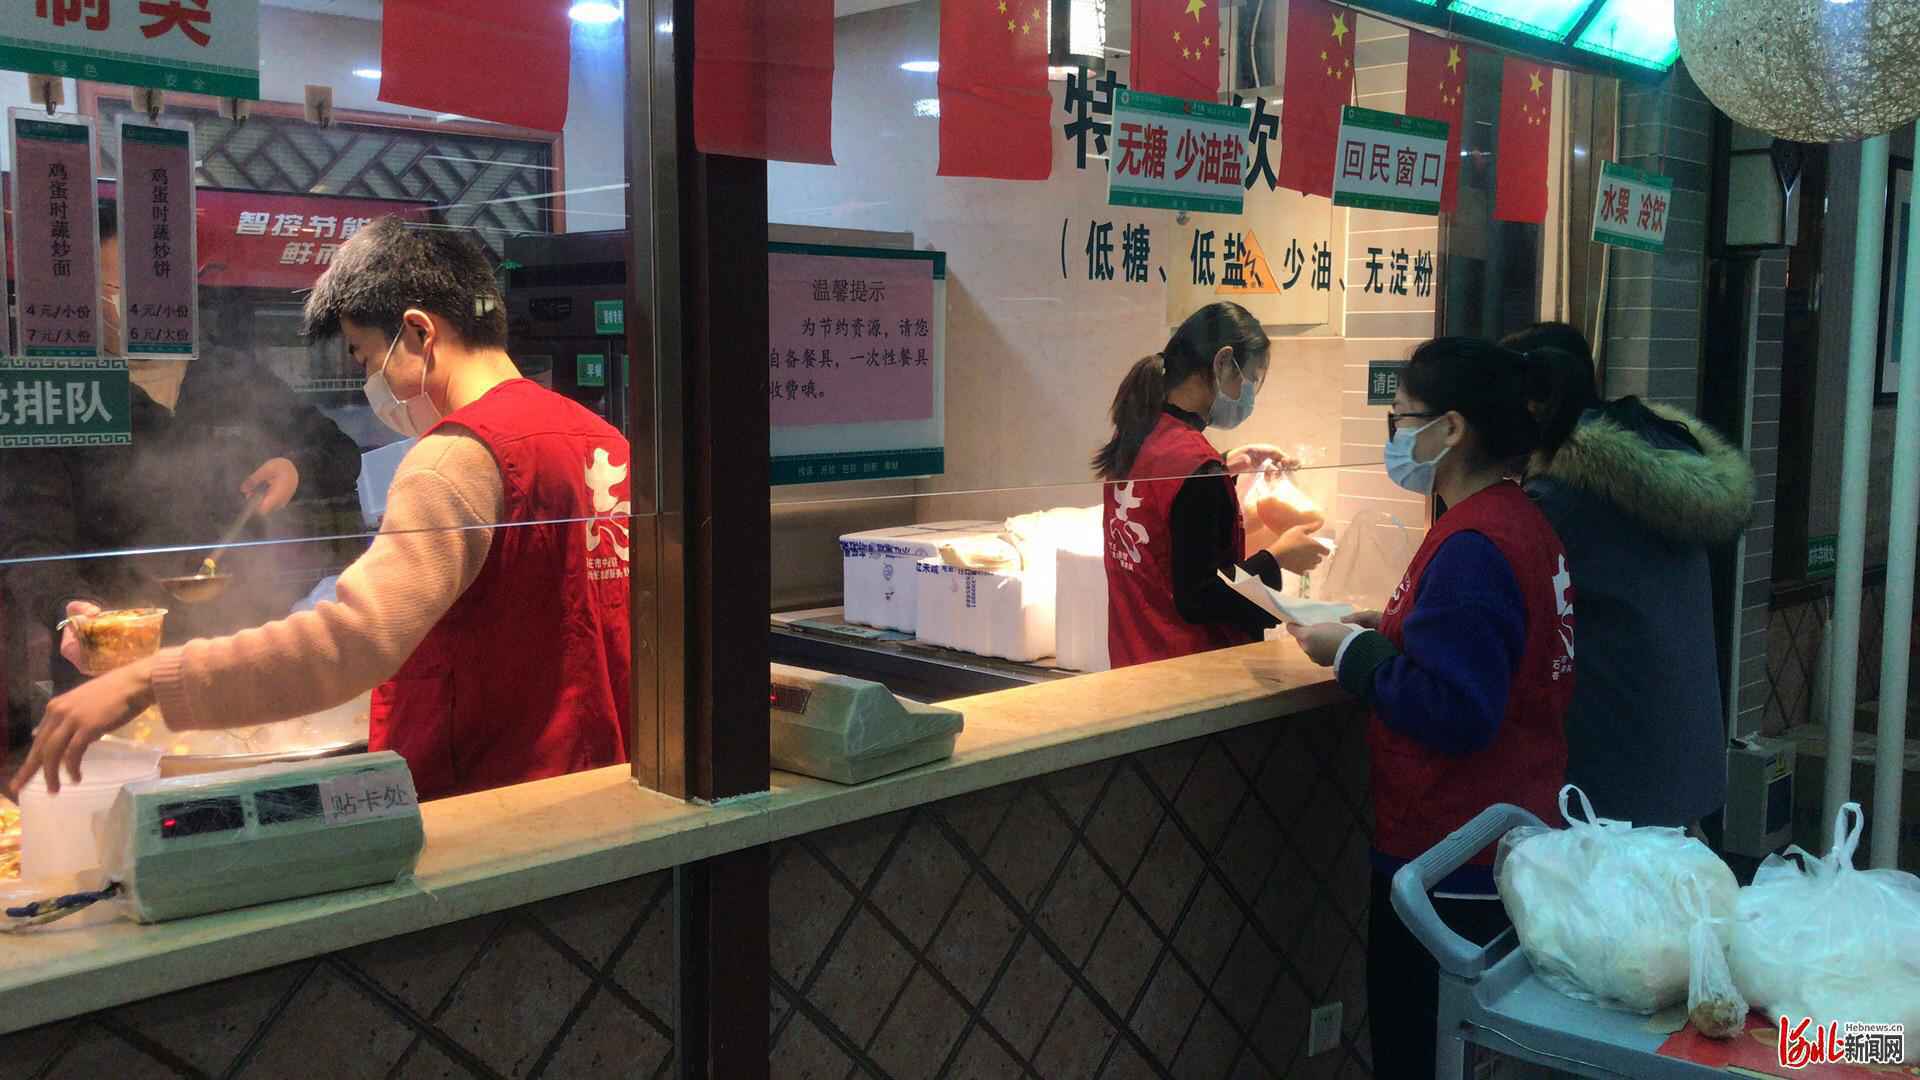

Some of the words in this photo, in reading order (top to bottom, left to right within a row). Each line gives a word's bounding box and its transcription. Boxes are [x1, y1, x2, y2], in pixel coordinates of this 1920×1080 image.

[1116, 122, 1169, 180] 无糖
[1174, 128, 1245, 186] 少油盐
[1343, 140, 1441, 188] 回民窗口
[1601, 184, 1631, 225] 水果
[1637, 192, 1666, 233] 冷饮
[812, 279, 887, 302] 温馨提示
[0, 380, 113, 426] 排队
[329, 783, 410, 818] 贴卡处
